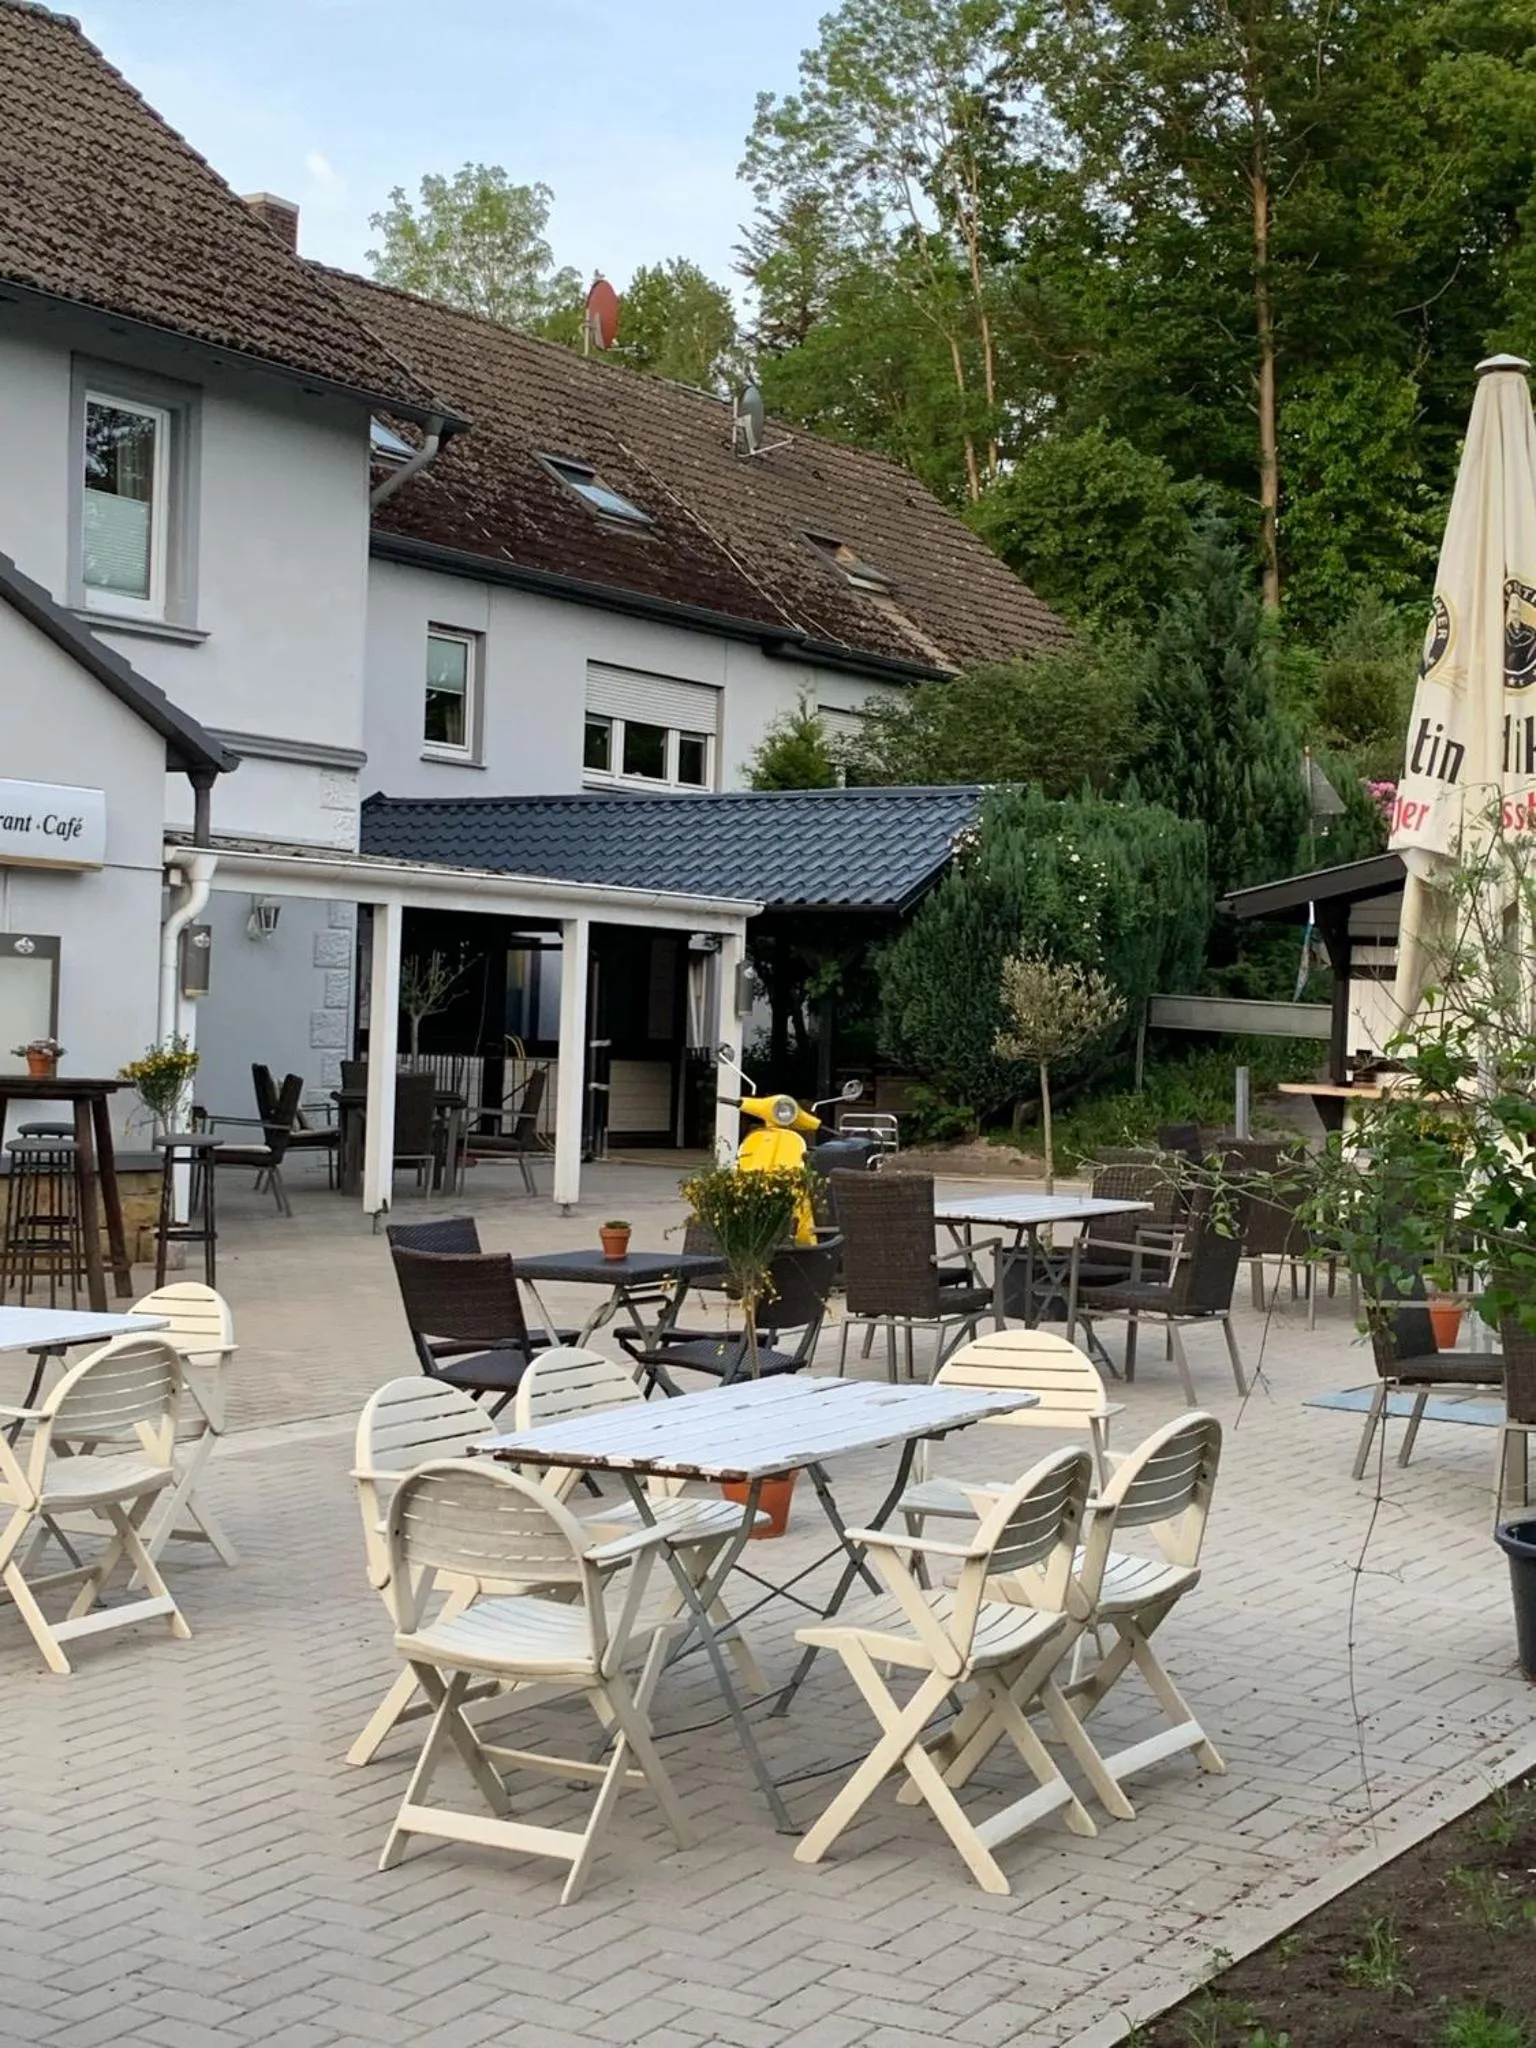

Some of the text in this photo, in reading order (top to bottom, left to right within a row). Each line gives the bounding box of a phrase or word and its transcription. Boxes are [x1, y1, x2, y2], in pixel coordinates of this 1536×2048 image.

[1401, 718, 1465, 784] tin
[0, 814, 84, 841] ant Café
